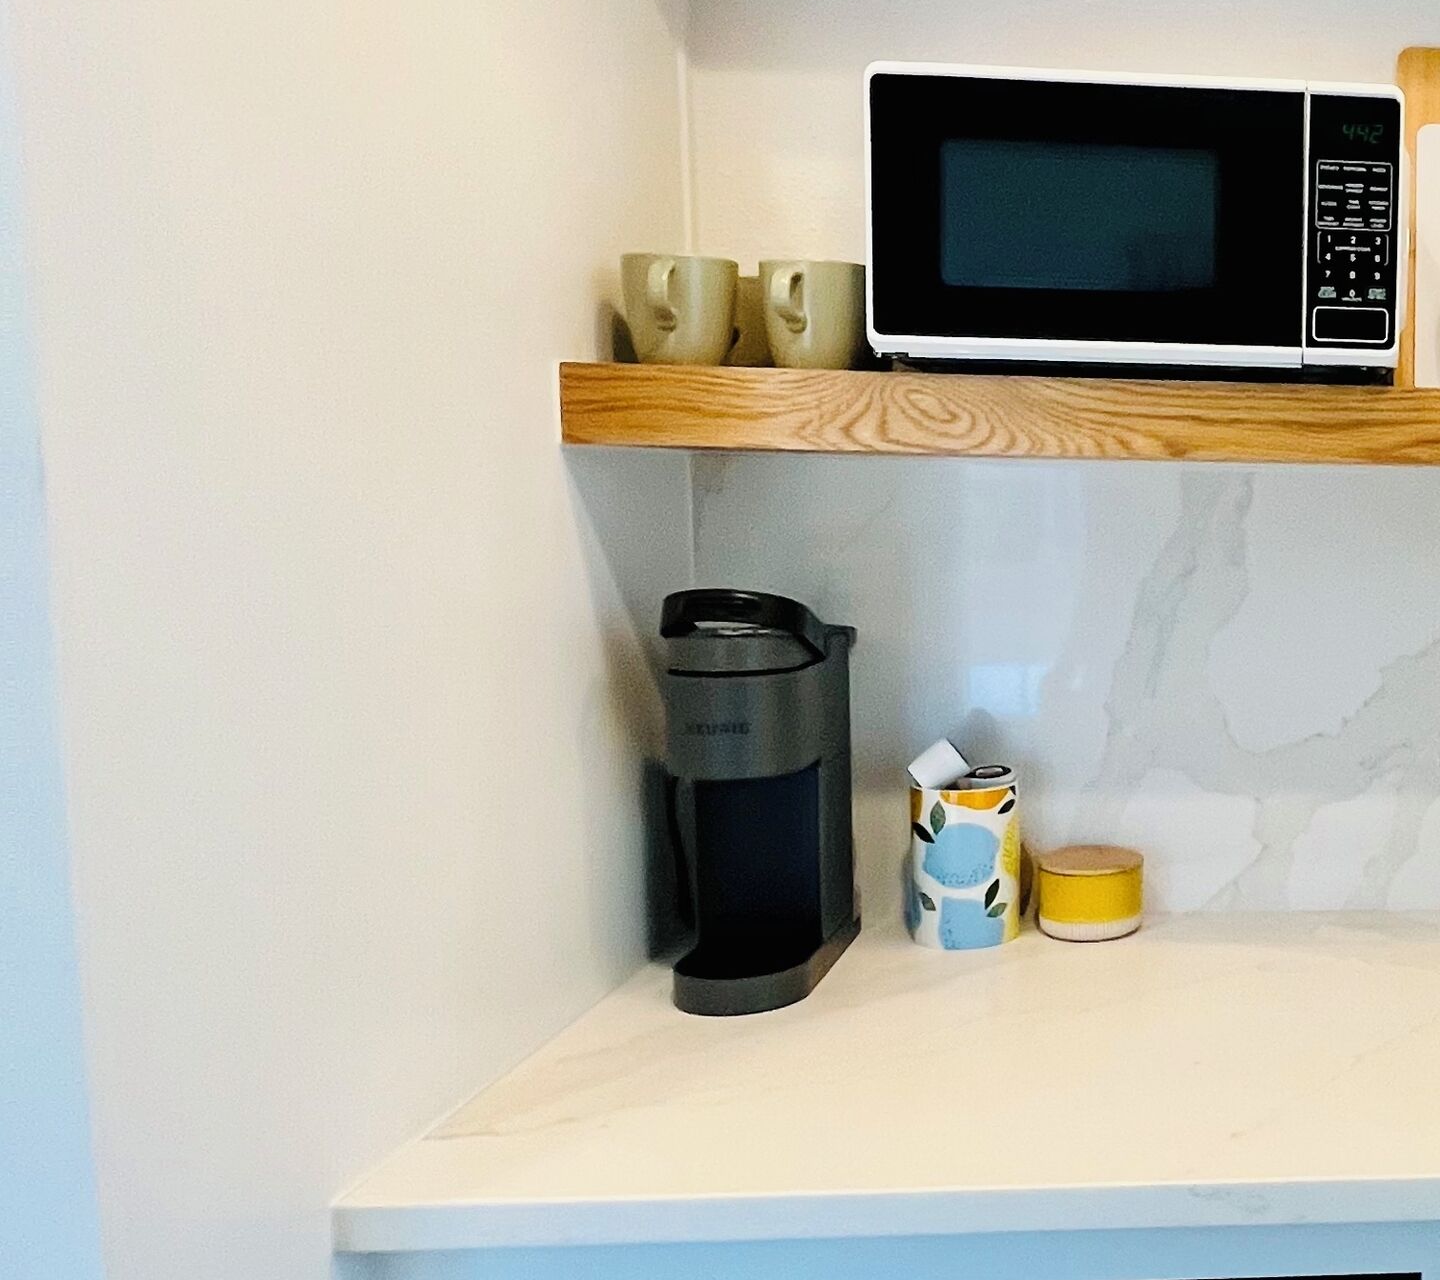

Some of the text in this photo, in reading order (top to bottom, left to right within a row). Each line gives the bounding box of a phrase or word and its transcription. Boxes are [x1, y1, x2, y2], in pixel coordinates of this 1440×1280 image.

[1326, 234, 1382, 246] 1 2 3
[1324, 252, 1381, 263] 4 5 6
[1324, 270, 1381, 280] 7 8 9
[1349, 289, 1356, 297] 0
